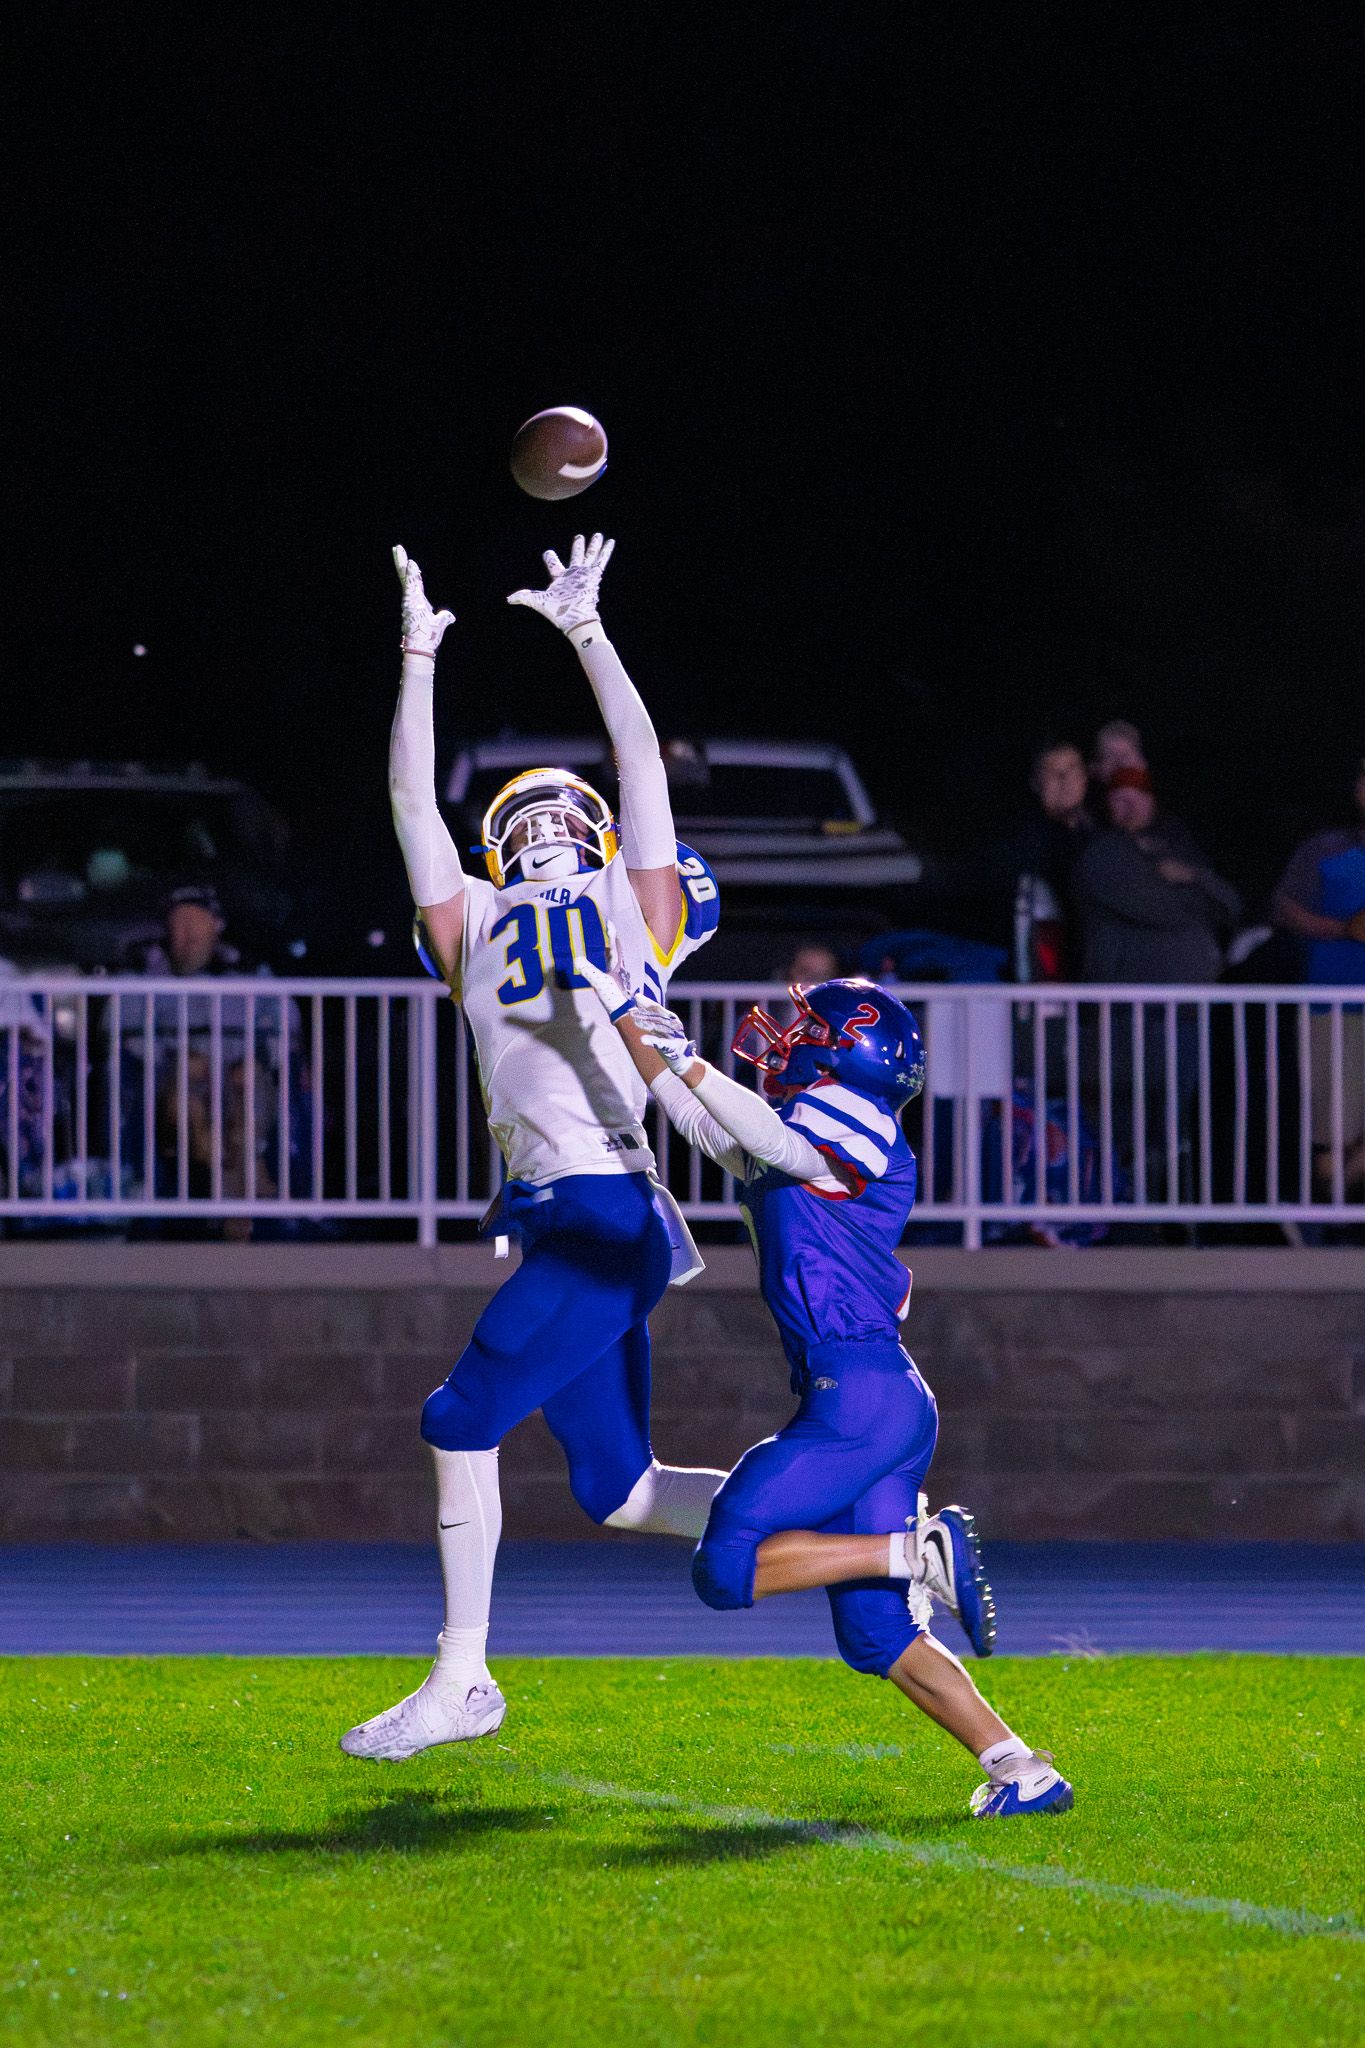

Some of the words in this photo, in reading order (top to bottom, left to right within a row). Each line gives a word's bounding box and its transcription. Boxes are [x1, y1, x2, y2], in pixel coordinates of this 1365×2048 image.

[677, 857, 717, 903] 30
[489, 895, 609, 1005] 30
[841, 1003, 881, 1042] 2
